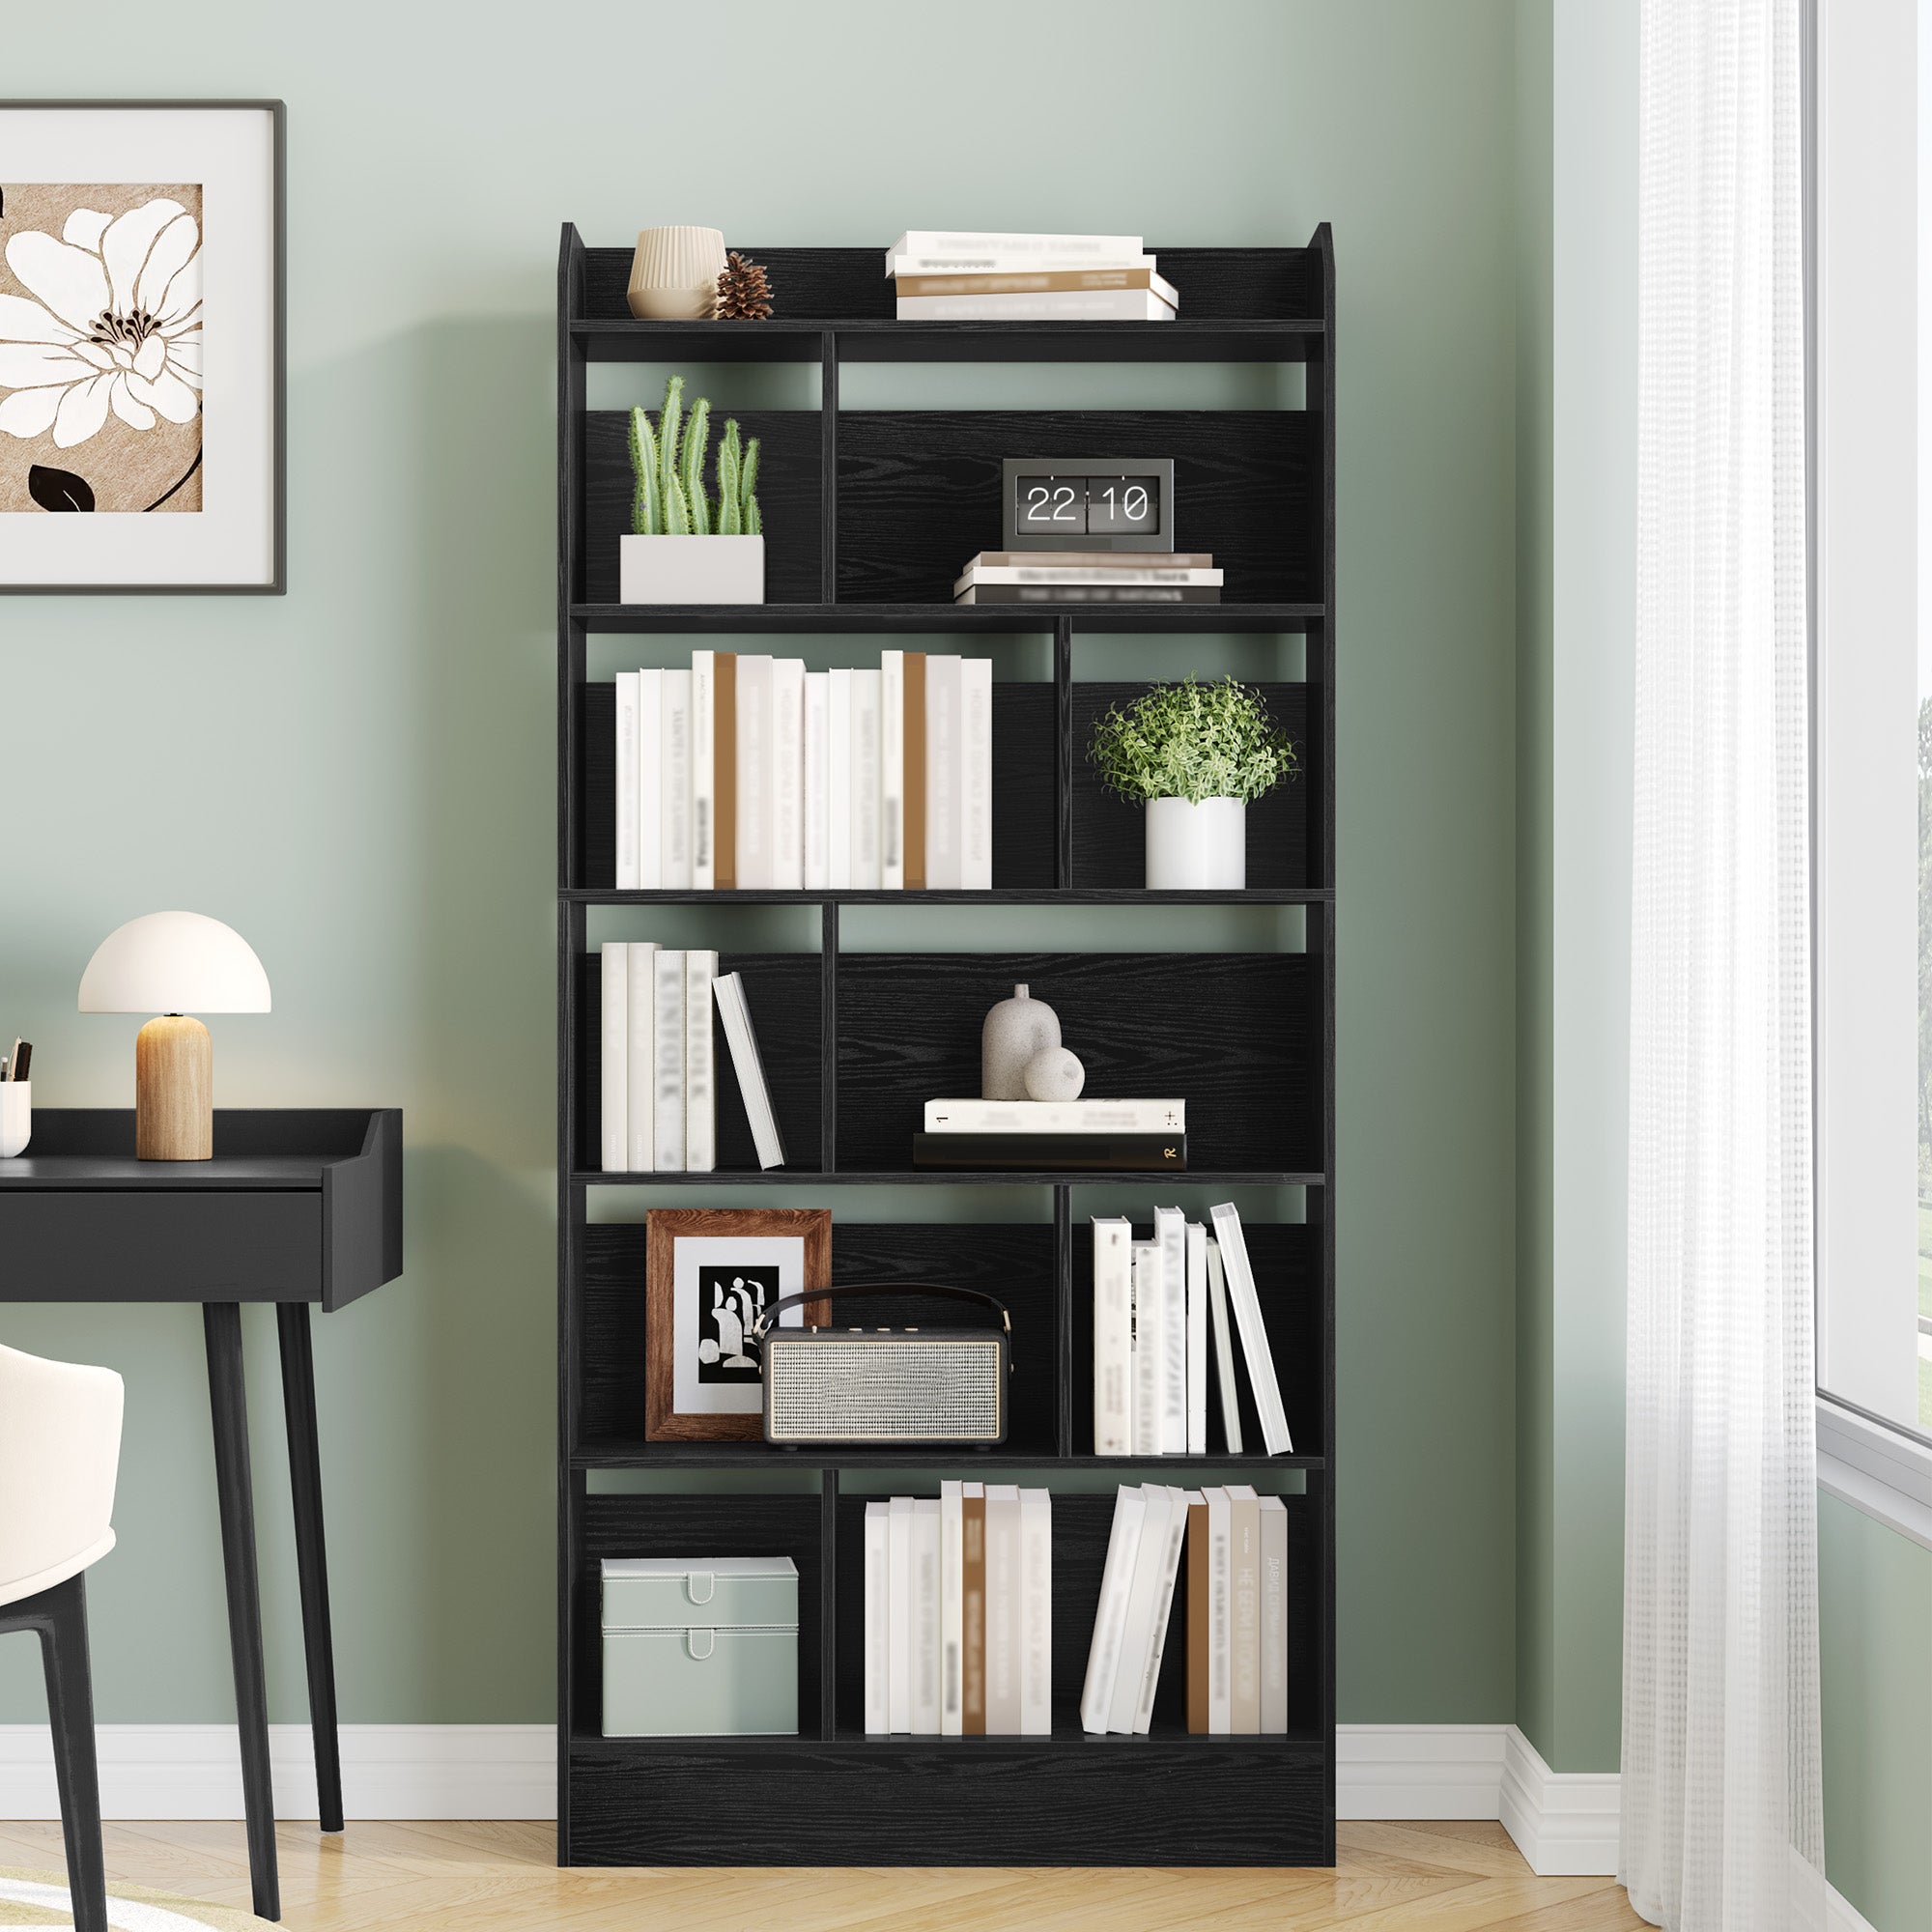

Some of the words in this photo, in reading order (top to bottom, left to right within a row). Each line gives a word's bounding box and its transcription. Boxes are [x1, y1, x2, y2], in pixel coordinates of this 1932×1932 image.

[1027, 487, 1076, 521] 22
[1102, 486, 1148, 521] 10
[1163, 1148, 1177, 1159] R
